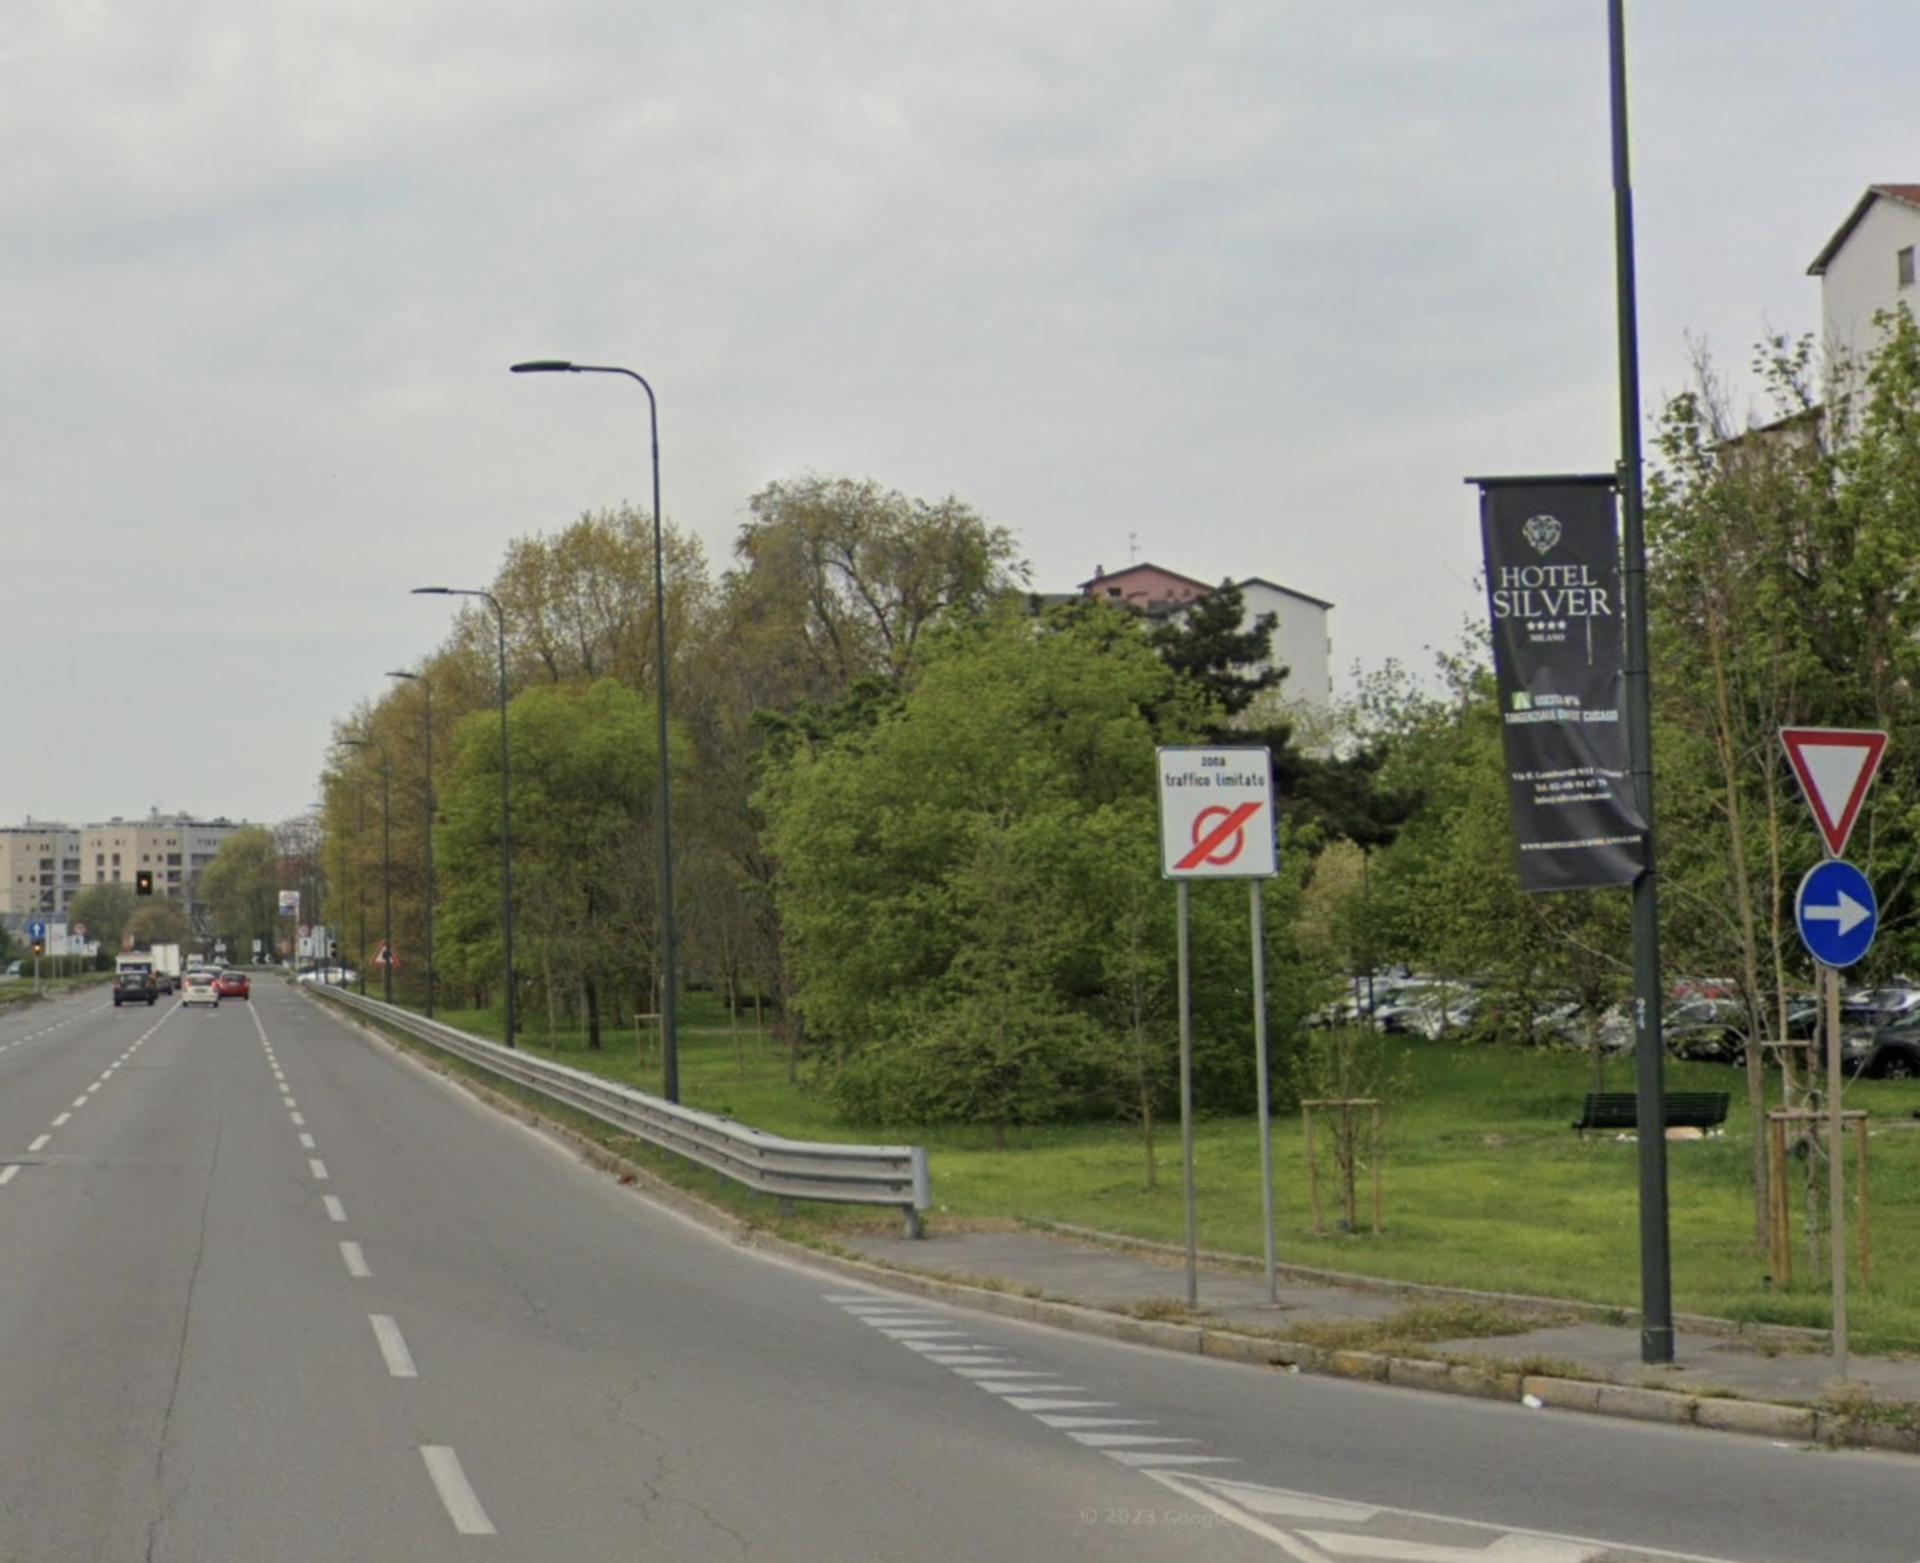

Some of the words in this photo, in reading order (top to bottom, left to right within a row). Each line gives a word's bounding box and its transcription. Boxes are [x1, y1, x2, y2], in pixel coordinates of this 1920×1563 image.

[1501, 565, 1598, 588] HOTEL
[1493, 588, 1612, 618] SILVER
[1201, 756, 1226, 767] zona
[1166, 773, 1211, 786] traffico
[1215, 772, 1265, 786] limitato
